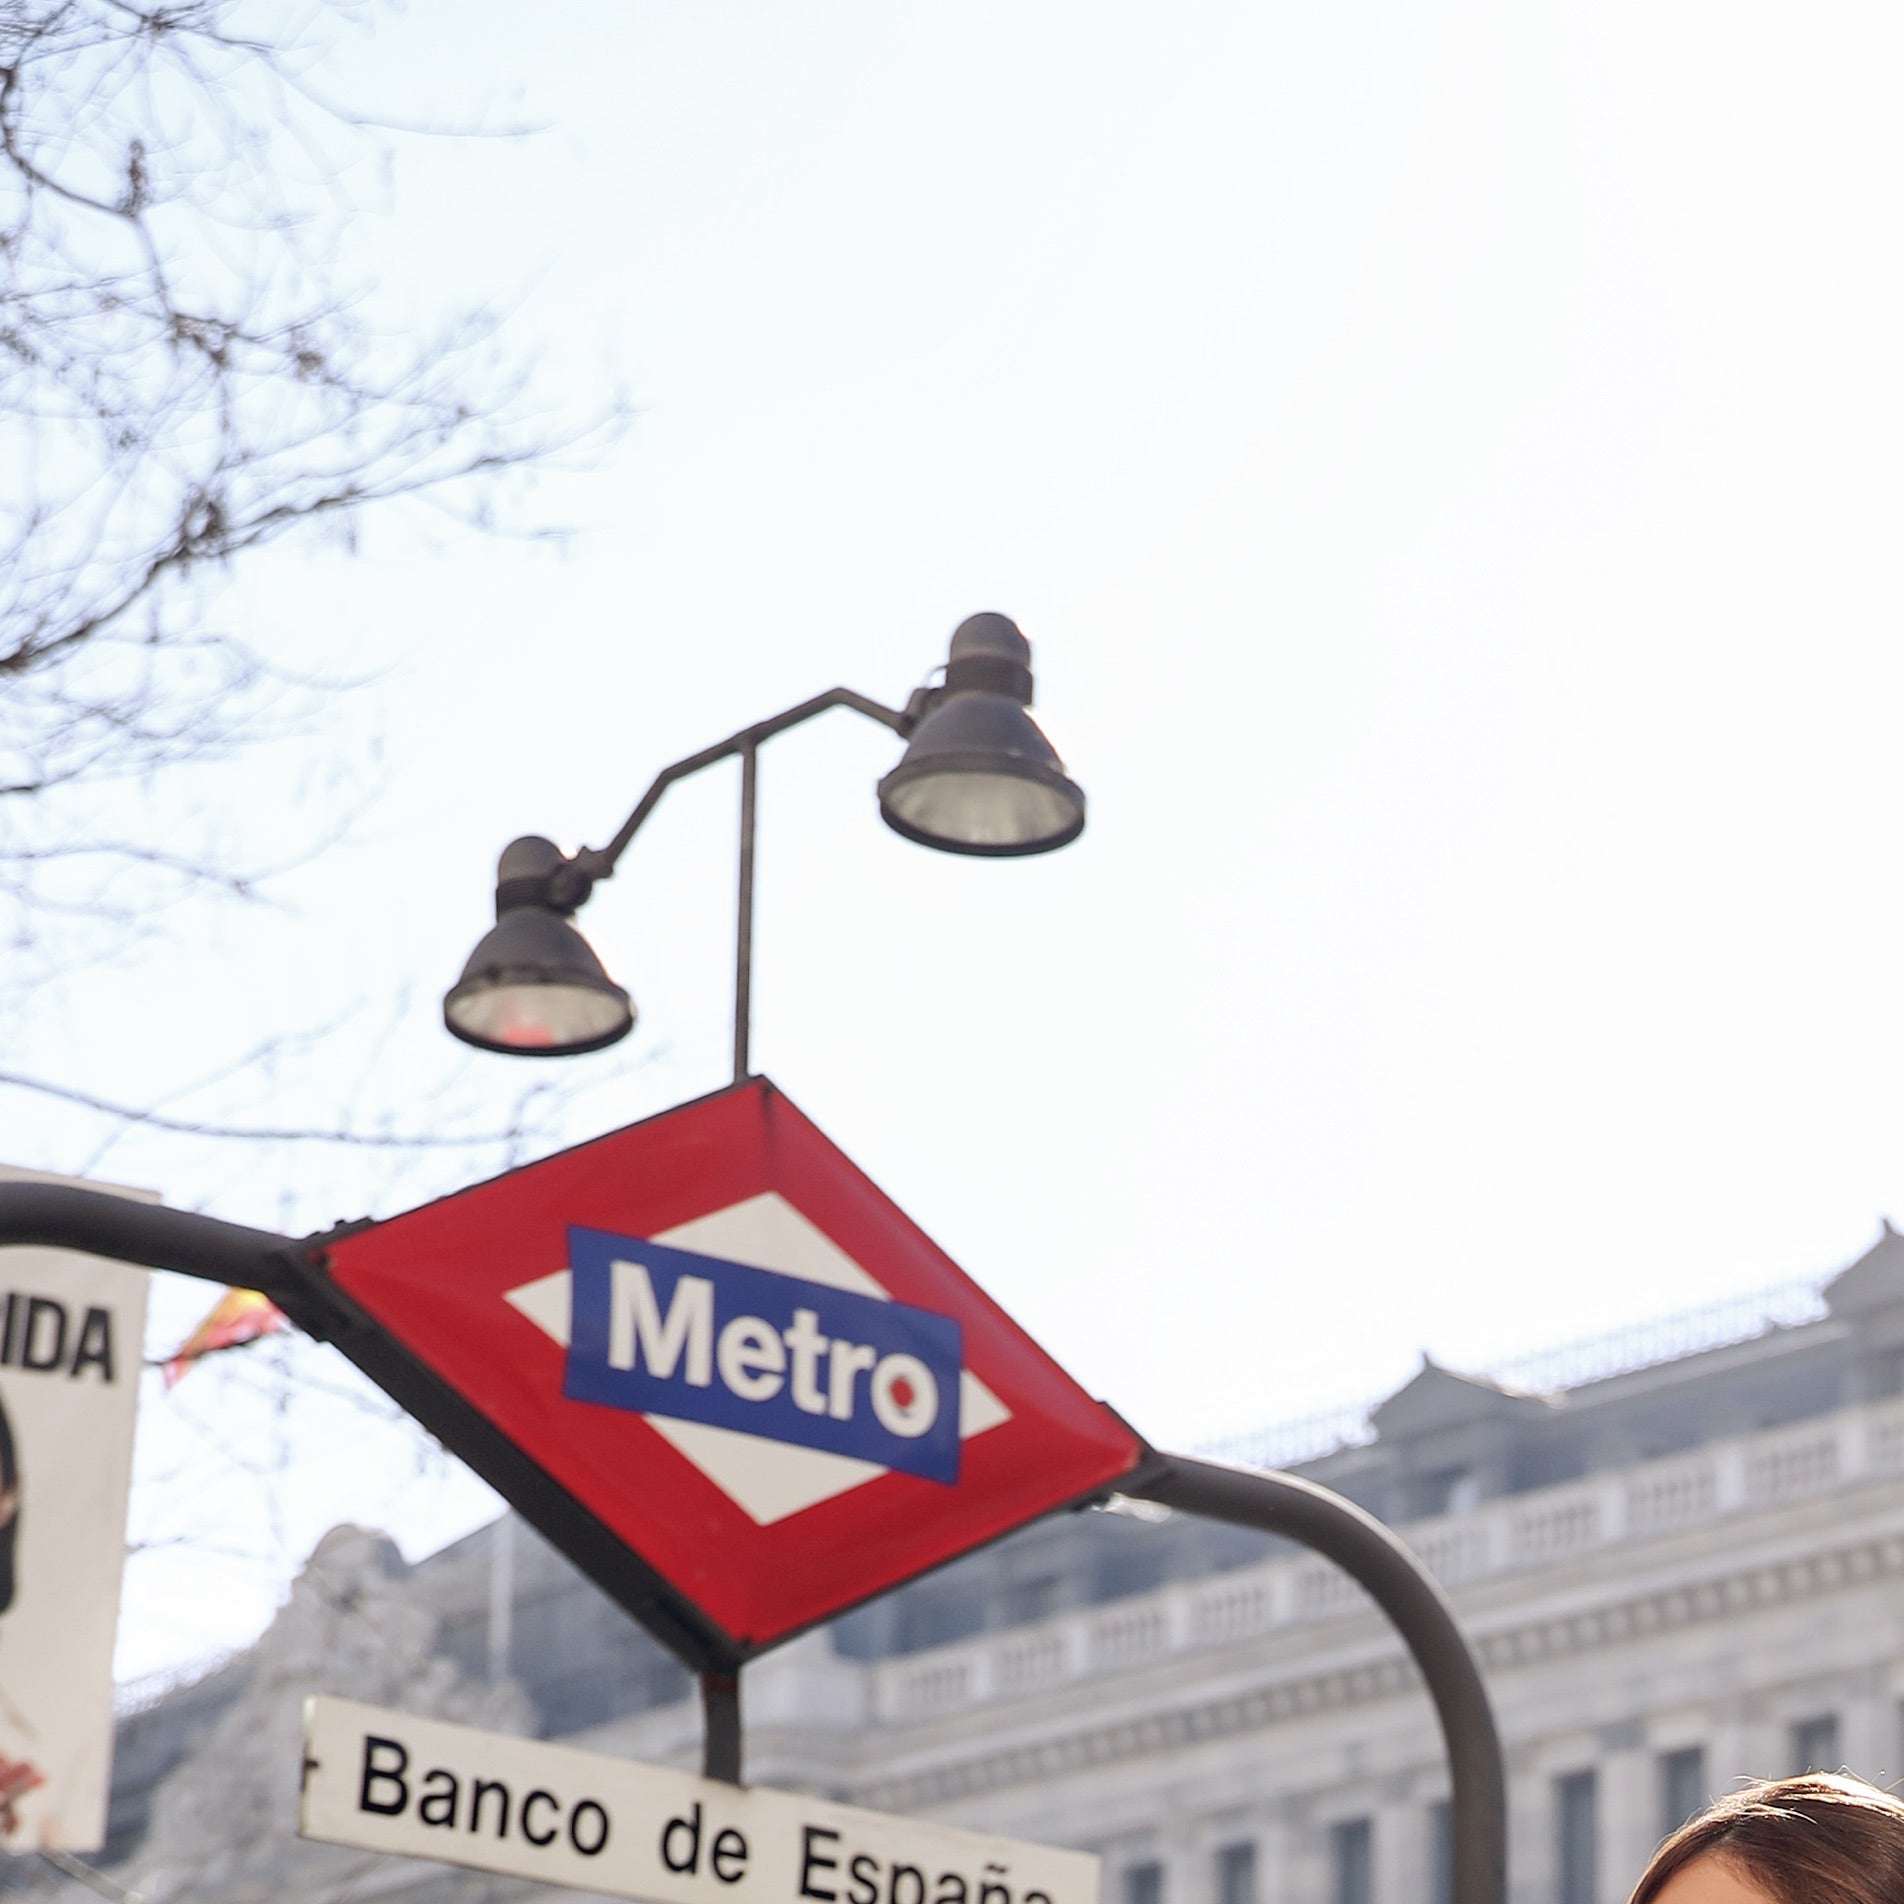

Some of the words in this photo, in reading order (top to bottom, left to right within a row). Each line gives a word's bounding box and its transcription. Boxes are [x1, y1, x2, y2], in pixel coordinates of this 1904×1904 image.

[607, 1259, 939, 1439] Metro
[357, 1734, 611, 1858] Banco
[661, 1802, 750, 1885] de
